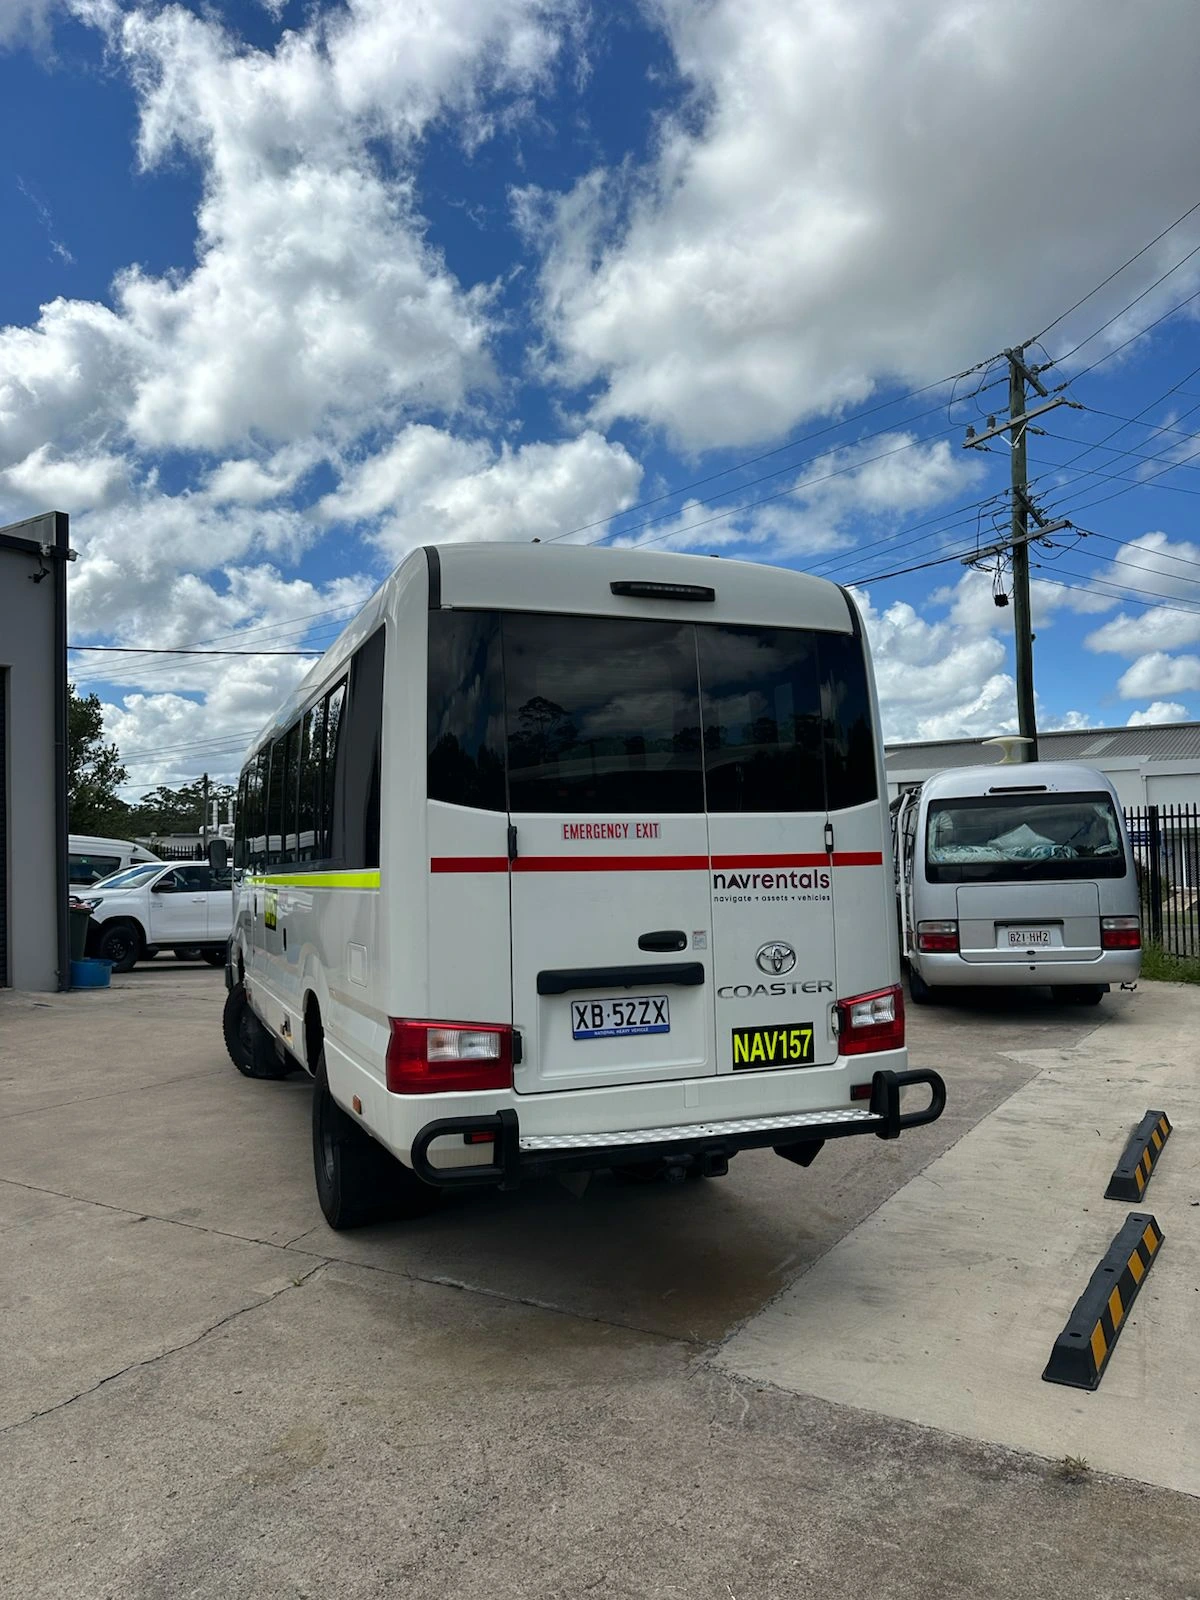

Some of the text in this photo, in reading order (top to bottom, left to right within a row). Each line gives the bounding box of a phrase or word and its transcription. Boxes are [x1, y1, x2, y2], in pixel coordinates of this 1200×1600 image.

[563, 823, 659, 840] EMERGENCY EXIT
[713, 895, 752, 904] navigate
[797, 894, 831, 902] vehicles
[717, 980, 833, 999] COASTER
[733, 1028, 812, 1063] NAV157
